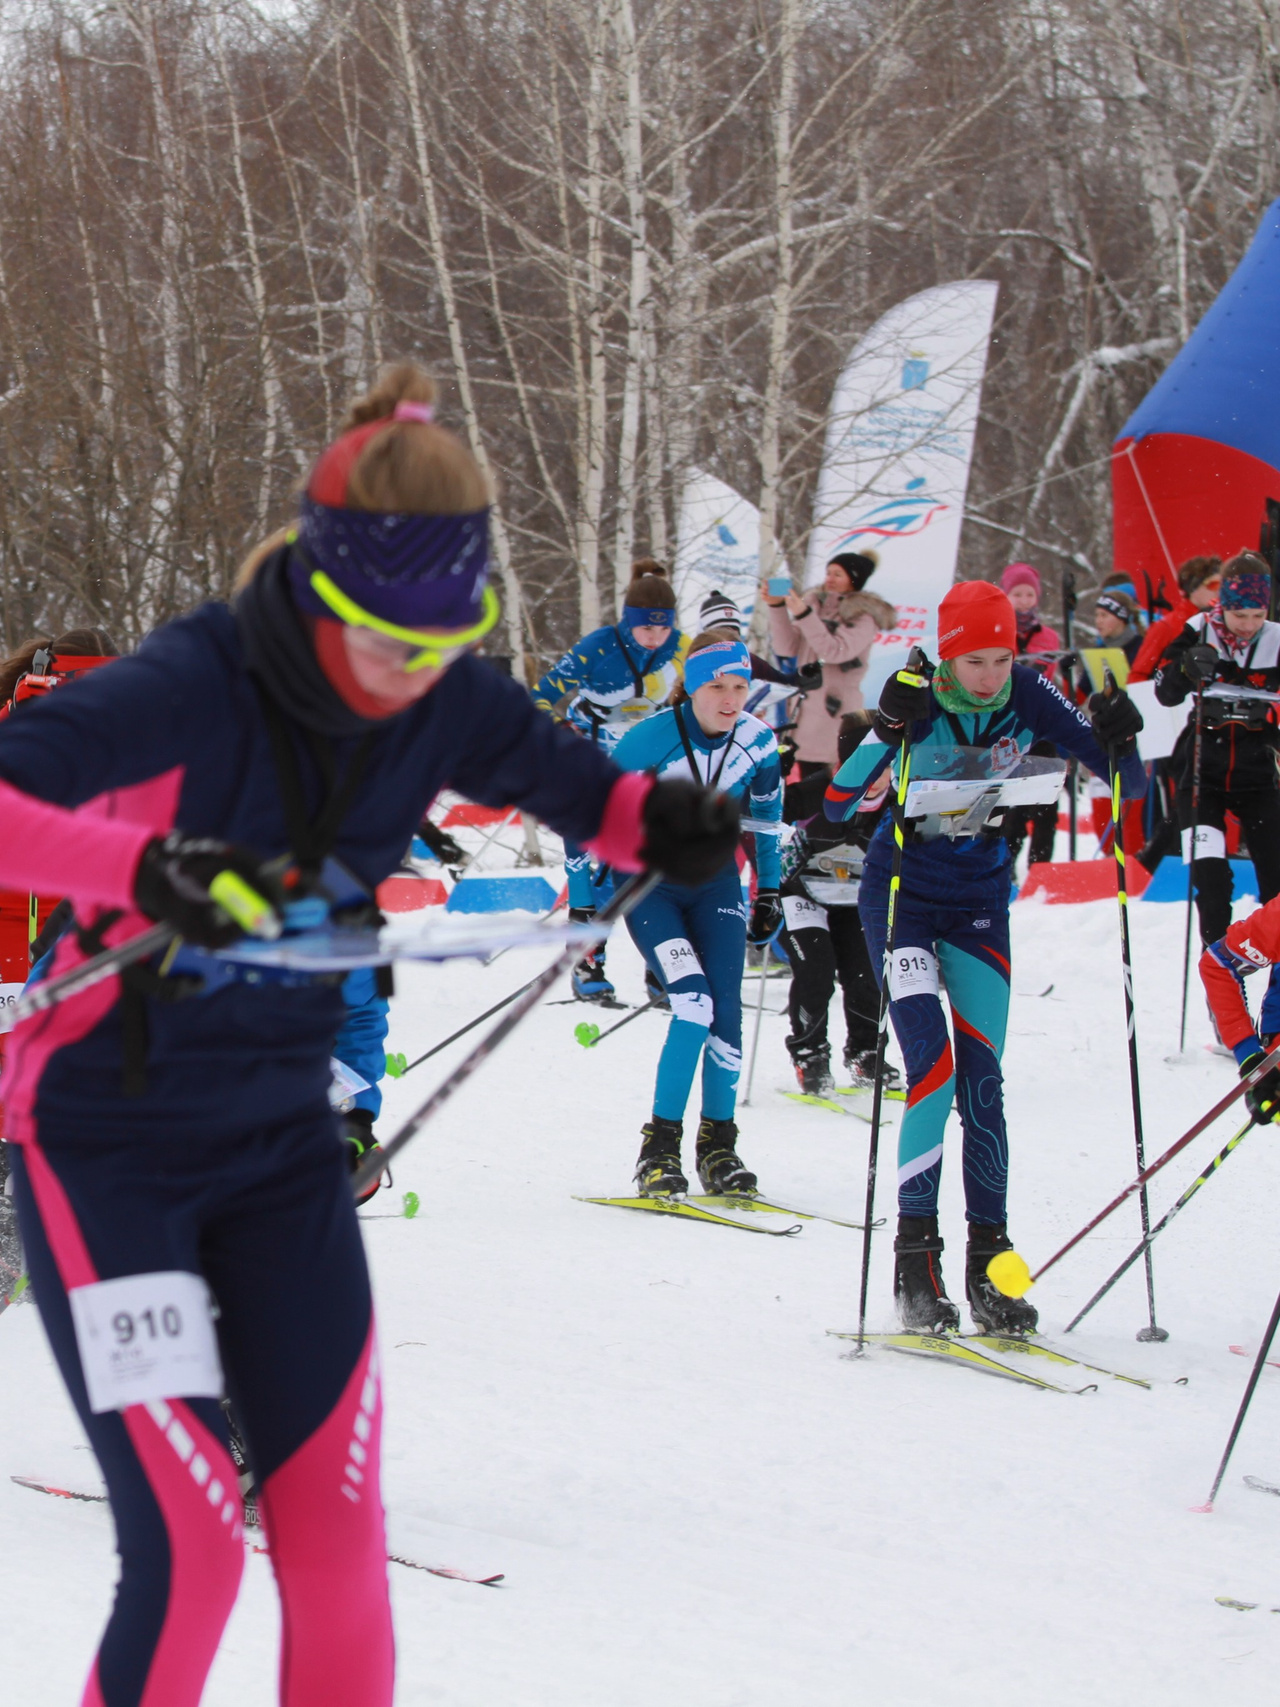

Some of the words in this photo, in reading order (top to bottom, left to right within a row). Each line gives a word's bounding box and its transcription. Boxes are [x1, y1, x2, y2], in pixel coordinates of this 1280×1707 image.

[795, 901, 817, 912] 943
[669, 947, 694, 960] 944
[899, 956, 928, 972] 915
[112, 1305, 182, 1345] 910
[921, 1338, 951, 1352] FISCHER
